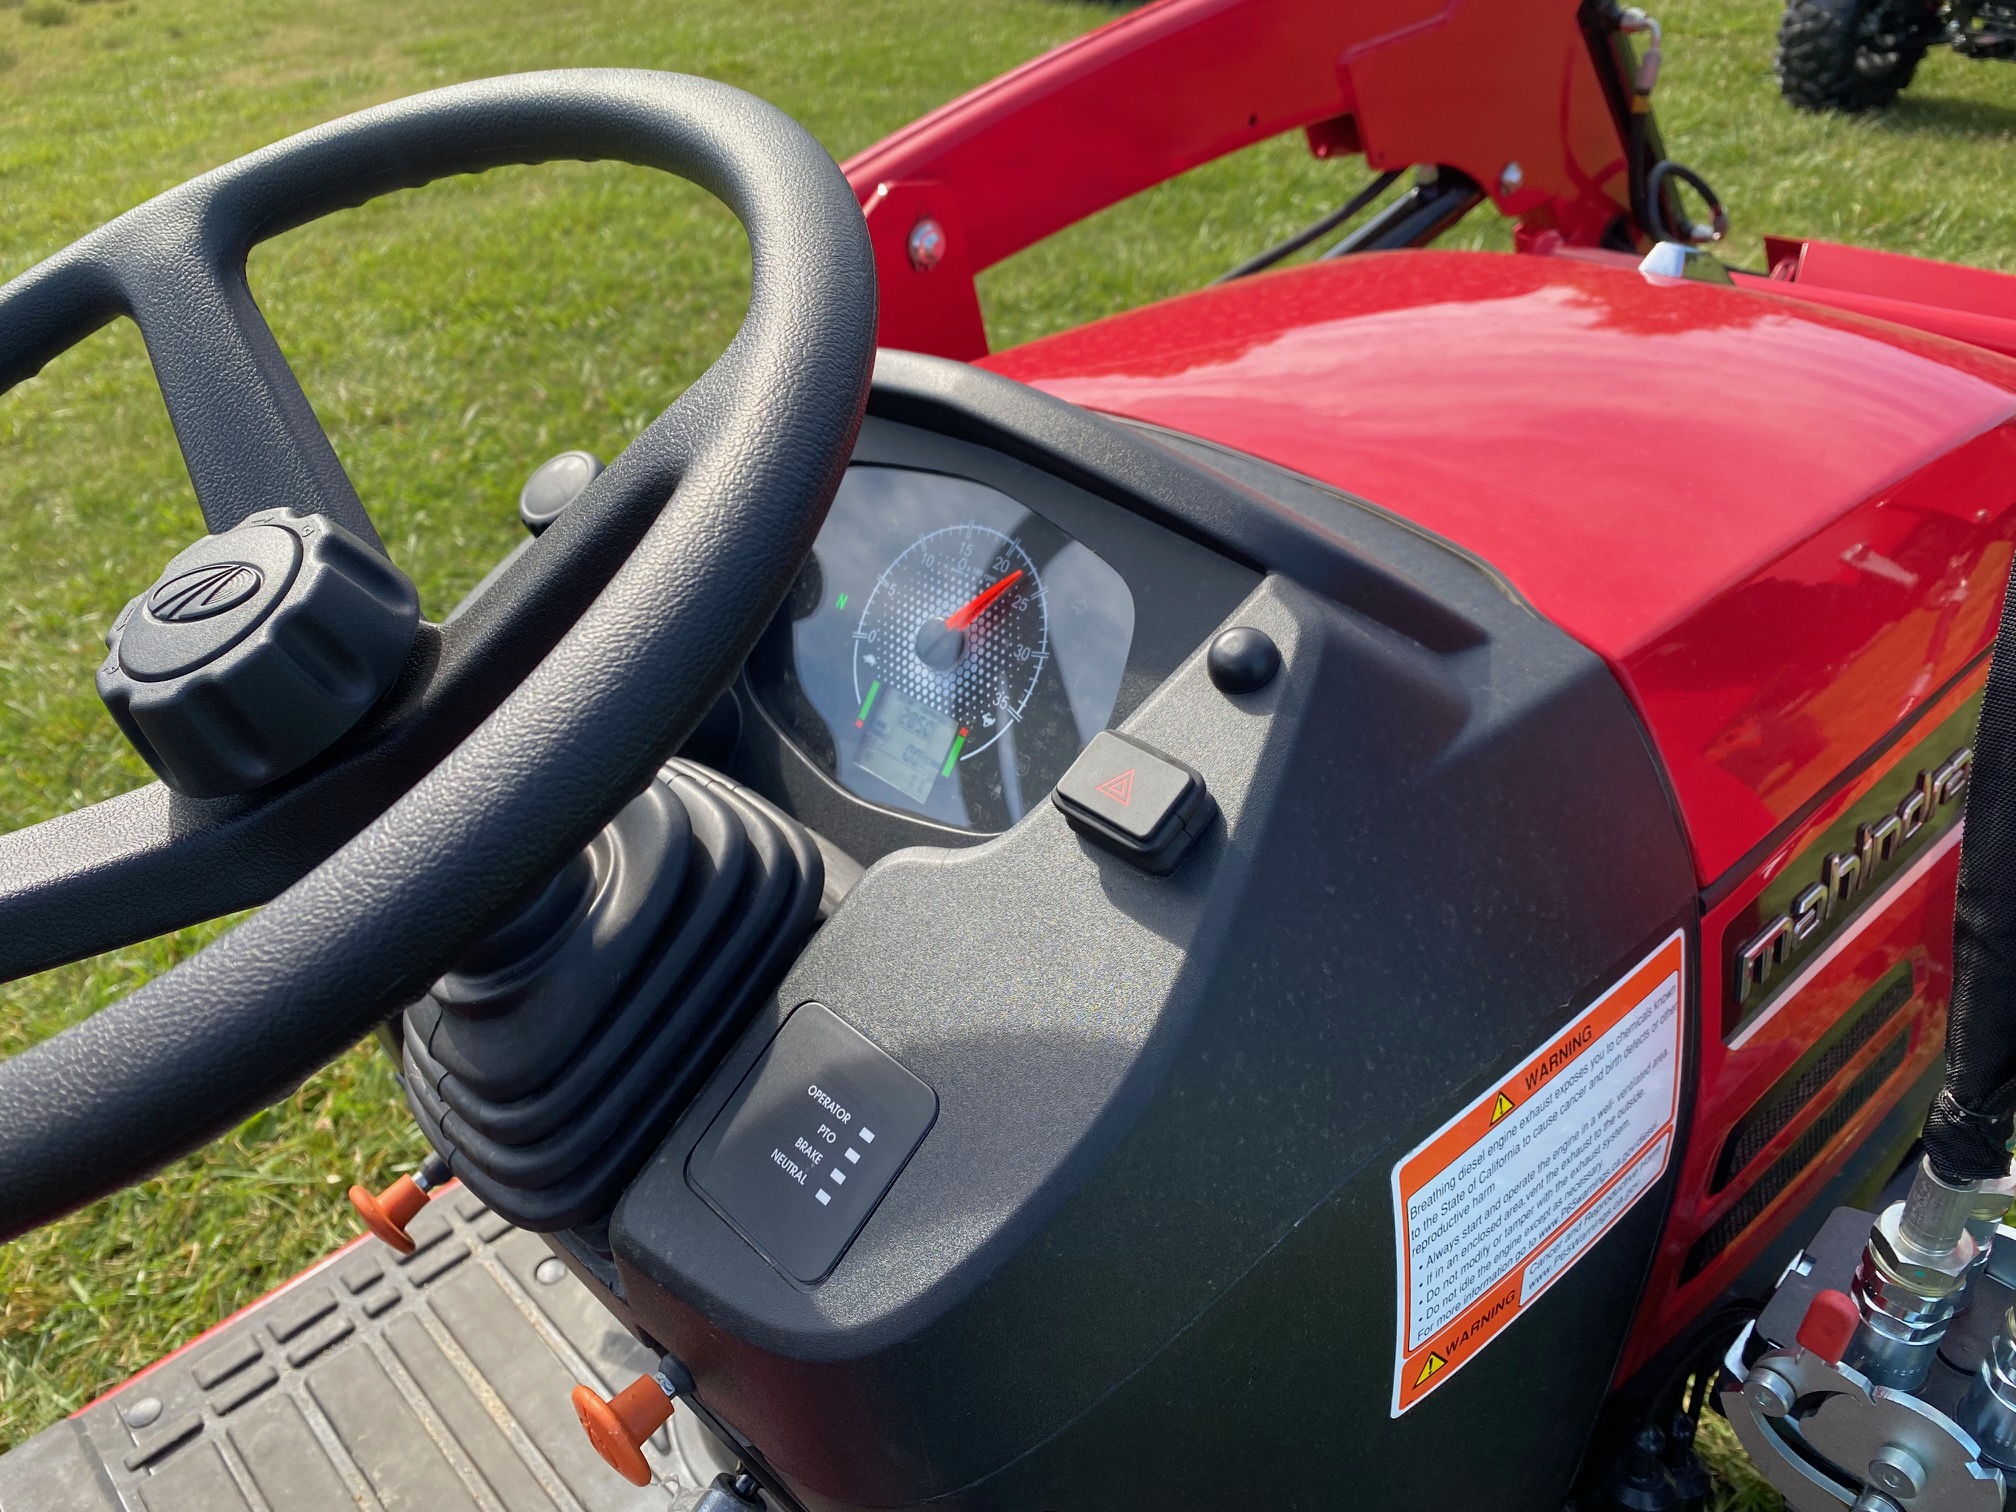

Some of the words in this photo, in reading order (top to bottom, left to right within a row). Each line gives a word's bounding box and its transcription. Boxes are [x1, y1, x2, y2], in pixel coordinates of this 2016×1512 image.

[921, 552, 935, 568] 10
[959, 541, 974, 557] 15
[992, 556, 1010, 573] 20
[835, 592, 848, 610] N
[887, 583, 897, 596] 5
[1011, 595, 1029, 612] 25
[868, 629, 877, 643] 0
[1013, 645, 1030, 661] 30
[992, 692, 1010, 710] 35
[1734, 748, 1973, 1004] mahindra
[1525, 1024, 1592, 1091] WARNING
[808, 1085, 851, 1124] OPERATOR
[1410, 1177, 1455, 1221] Breathing
[1458, 1149, 1485, 1181] diesel
[1487, 1125, 1517, 1157] engine
[1519, 1093, 1553, 1130] exhaust
[1554, 1063, 1588, 1099] exposes
[1590, 1049, 1604, 1072] you
[1606, 1041, 1614, 1055] to
[1615, 1006, 1652, 1046] chemicals
[1653, 984, 1676, 1012] known
[1411, 1227, 1420, 1241] to
[1423, 1212, 1438, 1231] the
[1440, 1190, 1465, 1216] State
[1467, 1177, 1476, 1194] of
[1478, 1143, 1520, 1184] California
[1522, 1134, 1531, 1148] to
[1532, 1111, 1558, 1139] cause
[1559, 1084, 1586, 1115] cancer
[1588, 1067, 1604, 1090] and
[1605, 1053, 1622, 1076] birth
[1623, 1028, 1650, 1059] defects
[1651, 1019, 1658, 1033] or
[1659, 1001, 1677, 1025] other
[794, 1137, 824, 1165] BRAKE
[817, 1124, 836, 1144] PTO
[770, 1148, 808, 1186] NEUTRAL
[1426, 1235, 1459, 1269] Always
[1461, 1214, 1482, 1239] start
[1484, 1196, 1500, 1220] and
[1503, 1170, 1535, 1204] operate
[1537, 1156, 1550, 1174] the
[1552, 1130, 1579, 1161] engine
[1581, 1122, 1588, 1135] in
[1590, 1116, 1595, 1127] a
[1616, 1062, 1650, 1102] ventilated
[1651, 1048, 1669, 1070] area.
[1426, 1271, 1432, 1286] If
[1435, 1265, 1443, 1279] in
[1446, 1253, 1458, 1270] an
[1461, 1214, 1501, 1257] enclosed
[1545, 1166, 1559, 1184] the
[1560, 1134, 1593, 1171] exhaust
[1593, 1128, 1601, 1141] to
[1603, 1115, 1616, 1132] the
[1617, 1088, 1645, 1119] outside.
[1412, 1204, 1470, 1258] reproductive
[1472, 1182, 1495, 1208] harm
[1426, 1286, 1440, 1303] Do
[1442, 1270, 1457, 1290] not
[1460, 1244, 1490, 1276] modify
[1492, 1233, 1502, 1248] or
[1504, 1205, 1534, 1239] tamper
[1536, 1189, 1553, 1210] with
[1555, 1175, 1568, 1193] the
[1570, 1144, 1601, 1179] exhaust
[1602, 1119, 1630, 1150] system.
[1529, 1240, 1562, 1275] Cancer
[1564, 1219, 1582, 1244] and
[1583, 1168, 1638, 1226] Reproductive
[1426, 1303, 1439, 1320] Do
[1442, 1288, 1457, 1308] not
[1459, 1274, 1475, 1294] idle
[1477, 1260, 1491, 1279] the
[1493, 1234, 1522, 1264] engine
[1524, 1206, 1551, 1238] except
[1552, 1197, 1562, 1212] as
[1564, 1160, 1603, 1201] necessary.
[1417, 1323, 1434, 1341] For
[1436, 1302, 1461, 1327] more
[1463, 1257, 1513, 1305] information
[1515, 1246, 1526, 1263] go
[1528, 1237, 1536, 1250] to
[1445, 1289, 1515, 1358] WARNING
